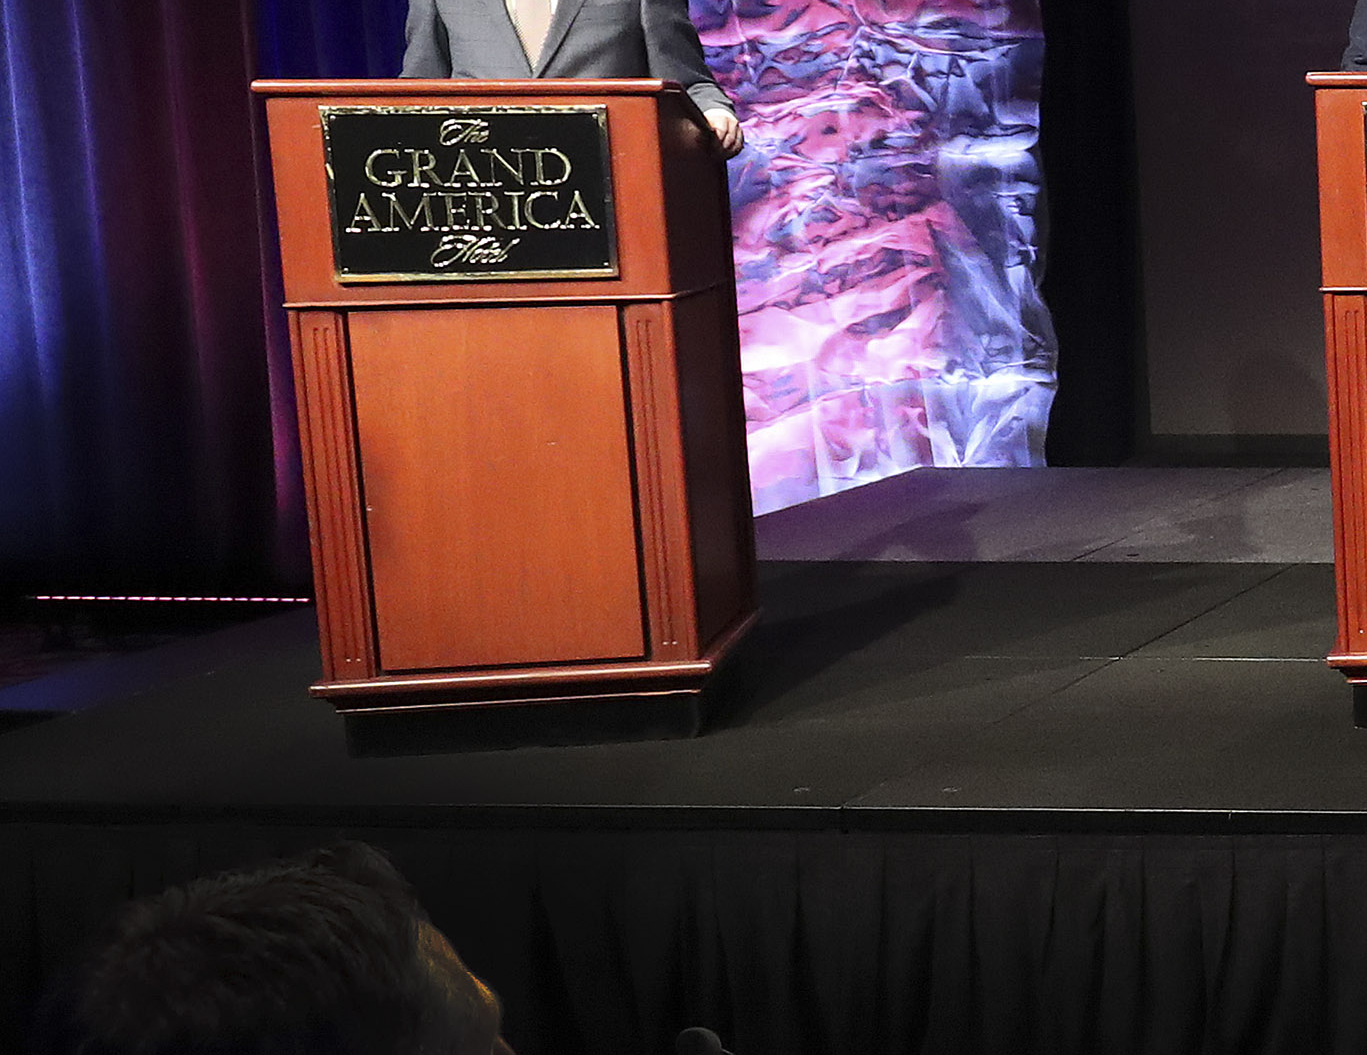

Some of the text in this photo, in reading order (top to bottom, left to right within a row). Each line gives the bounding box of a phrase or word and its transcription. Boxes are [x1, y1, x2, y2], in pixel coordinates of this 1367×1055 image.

[439, 118, 490, 146] The
[364, 148, 572, 187] GRAND
[345, 190, 600, 232] AMERICA
[430, 234, 521, 268] Hotel
